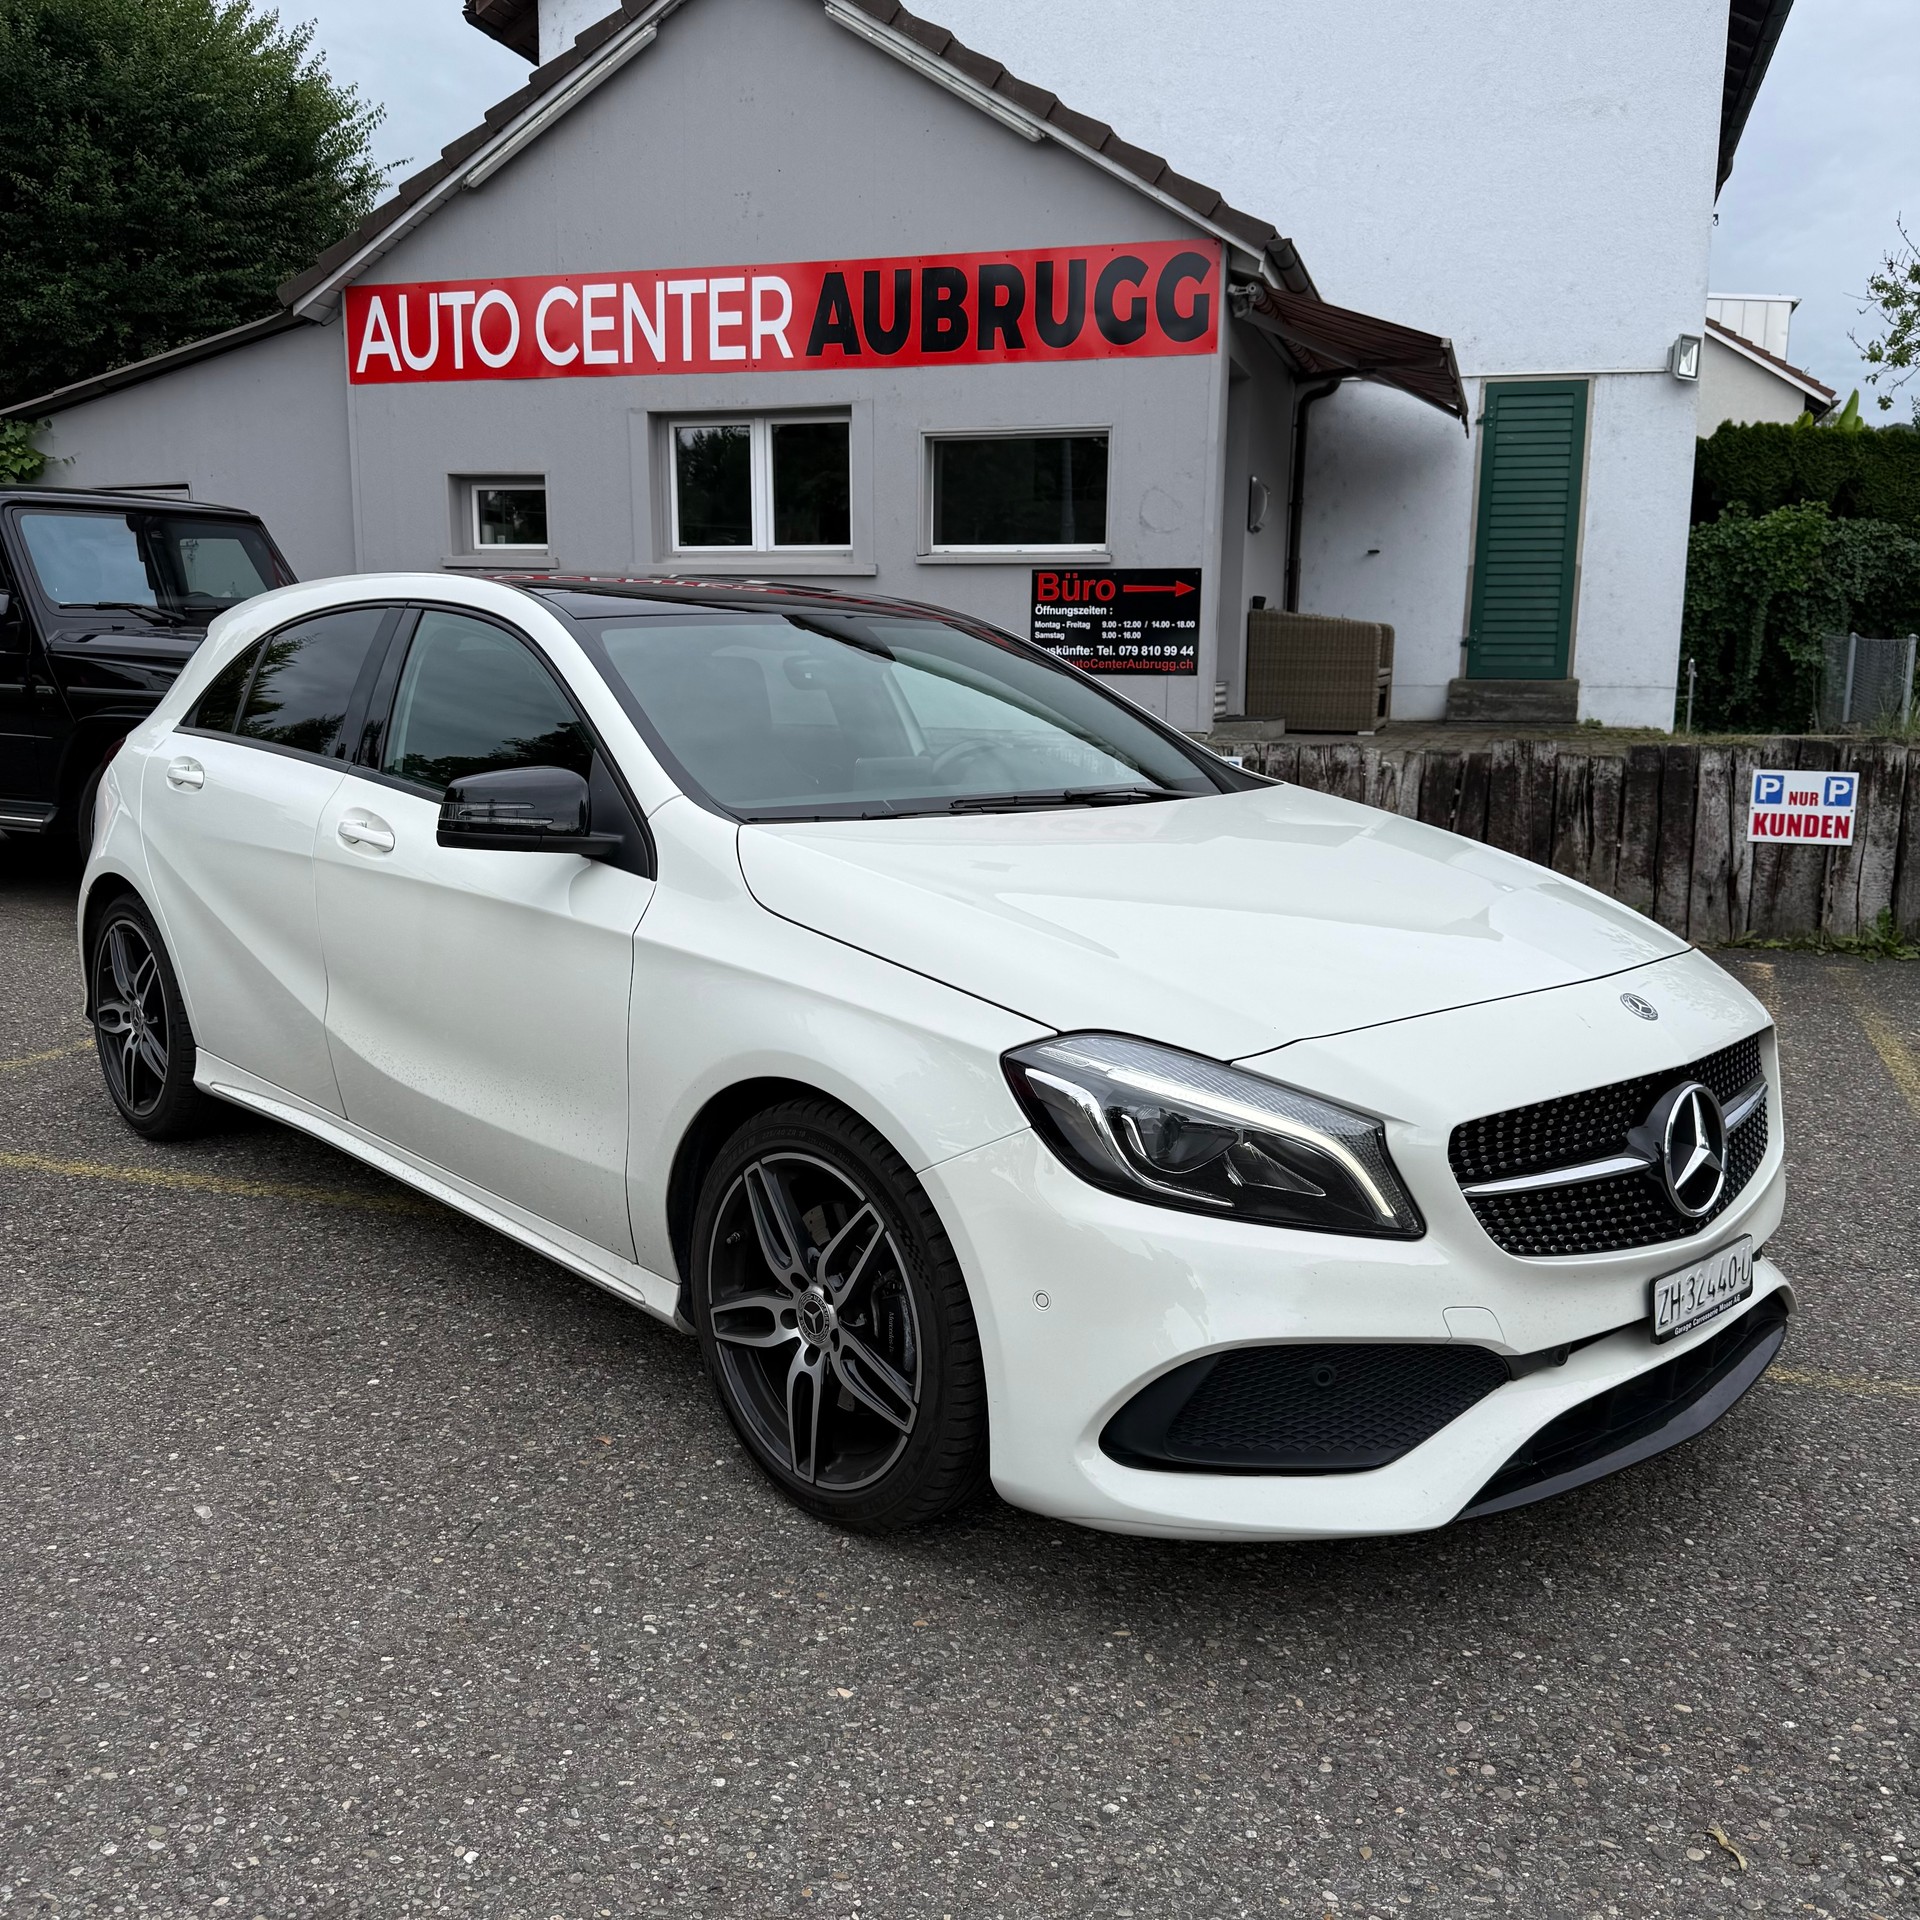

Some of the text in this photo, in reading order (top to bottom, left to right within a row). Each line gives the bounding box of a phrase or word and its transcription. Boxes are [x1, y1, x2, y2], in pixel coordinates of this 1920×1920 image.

[356, 251, 1212, 373] AUTO CENTER AUBRUGG
[1037, 572, 1116, 601] Büro
[1035, 603, 1107, 617] Öffnungszeiten
[1034, 620, 1061, 630] Montag
[1066, 620, 1091, 630] Freitag
[1101, 620, 1117, 629] 9.00
[1123, 620, 1142, 629] 12.00
[1151, 620, 1171, 629] 14.00
[1176, 620, 1196, 629] 18.00
[1034, 631, 1065, 641] Samstag
[1101, 631, 1117, 639] 9.00
[1123, 631, 1142, 639] 16.00
[1096, 645, 1116, 656] Tel.
[1118, 645, 1140, 656] 079
[1141, 645, 1161, 656] 810
[1163, 645, 1178, 656] 99
[1179, 645, 1195, 656] 44
[1788, 791, 1819, 806] NUR
[1752, 812, 1851, 839] KUNDEN
